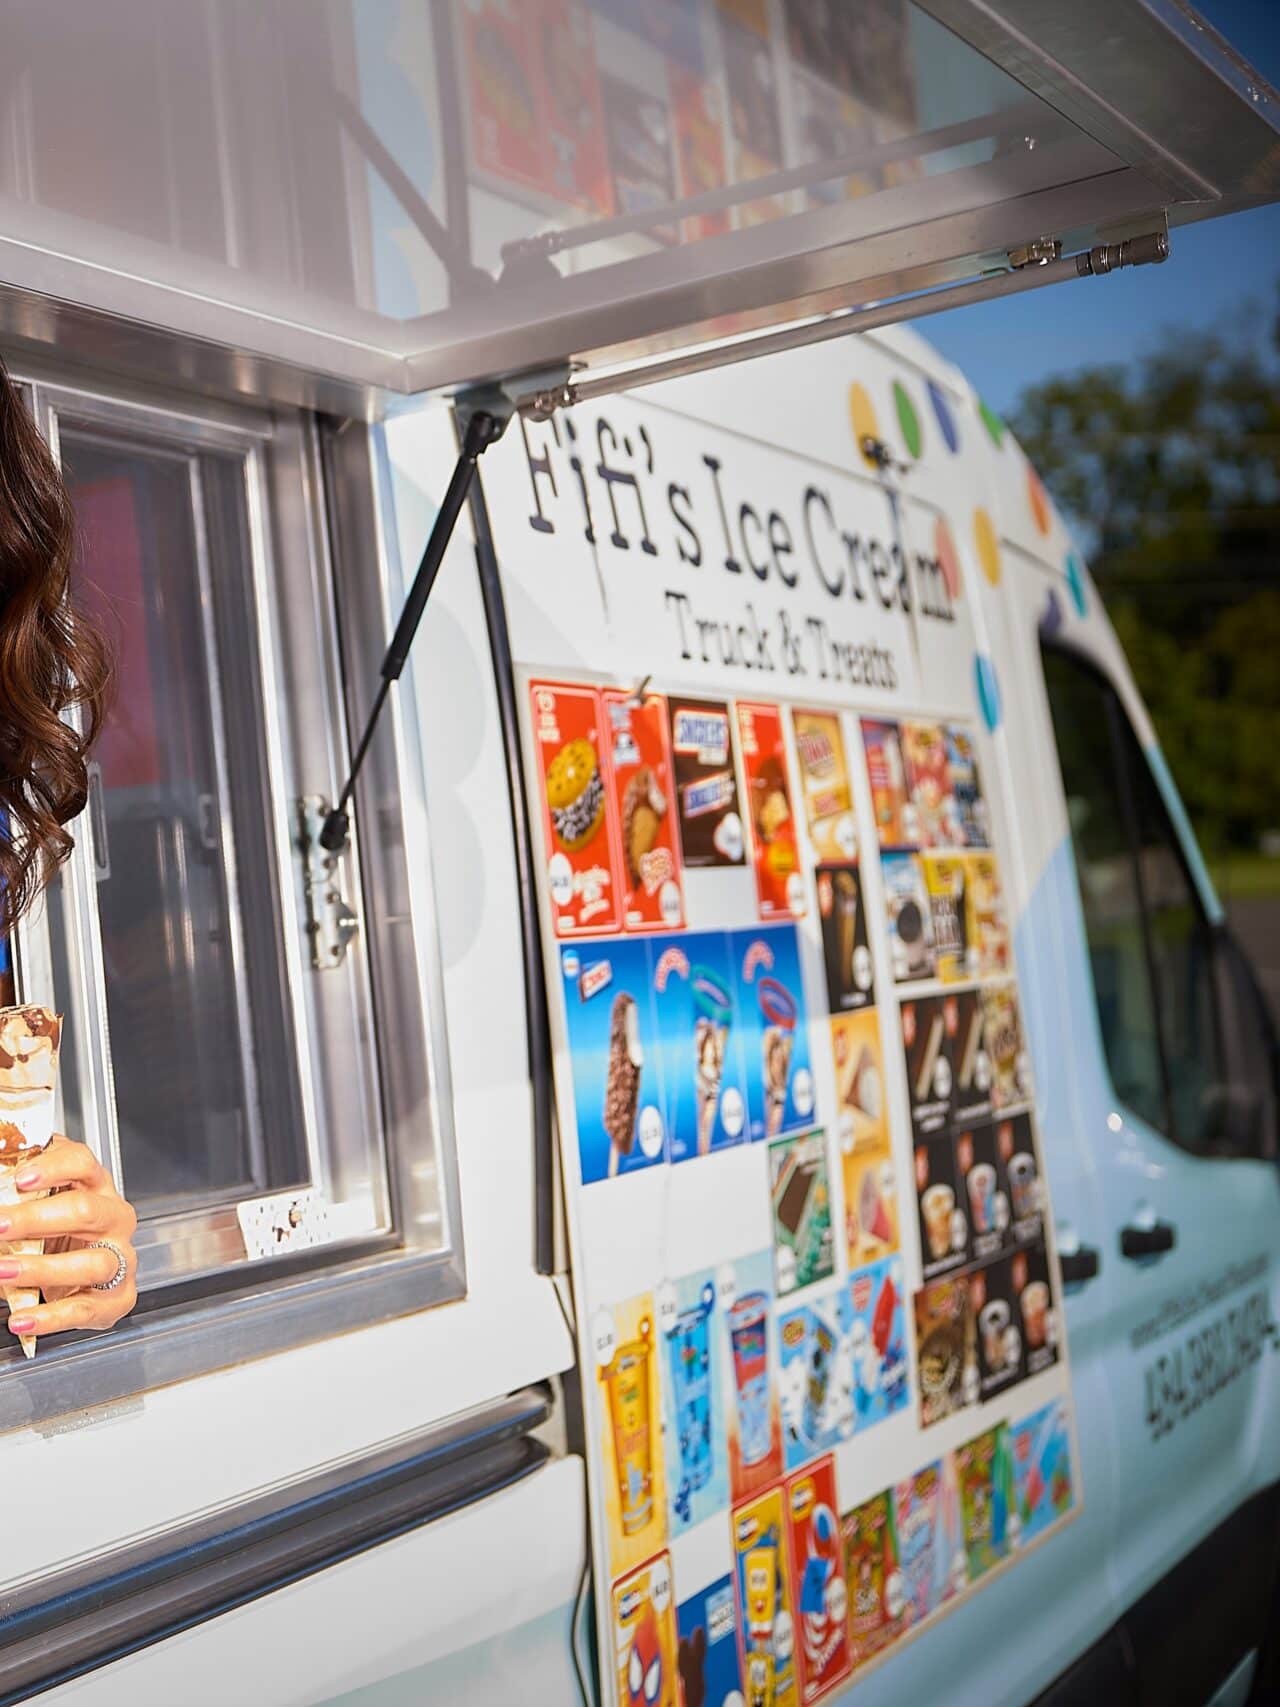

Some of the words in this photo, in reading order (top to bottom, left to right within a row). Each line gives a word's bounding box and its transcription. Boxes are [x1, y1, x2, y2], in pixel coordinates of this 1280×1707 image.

[521, 414, 702, 568] Fifi's
[703, 454, 800, 588] Ice
[803, 485, 956, 622] Cream
[665, 590, 775, 673] Truck
[776, 608, 809, 676] &
[806, 616, 898, 691] Treats
